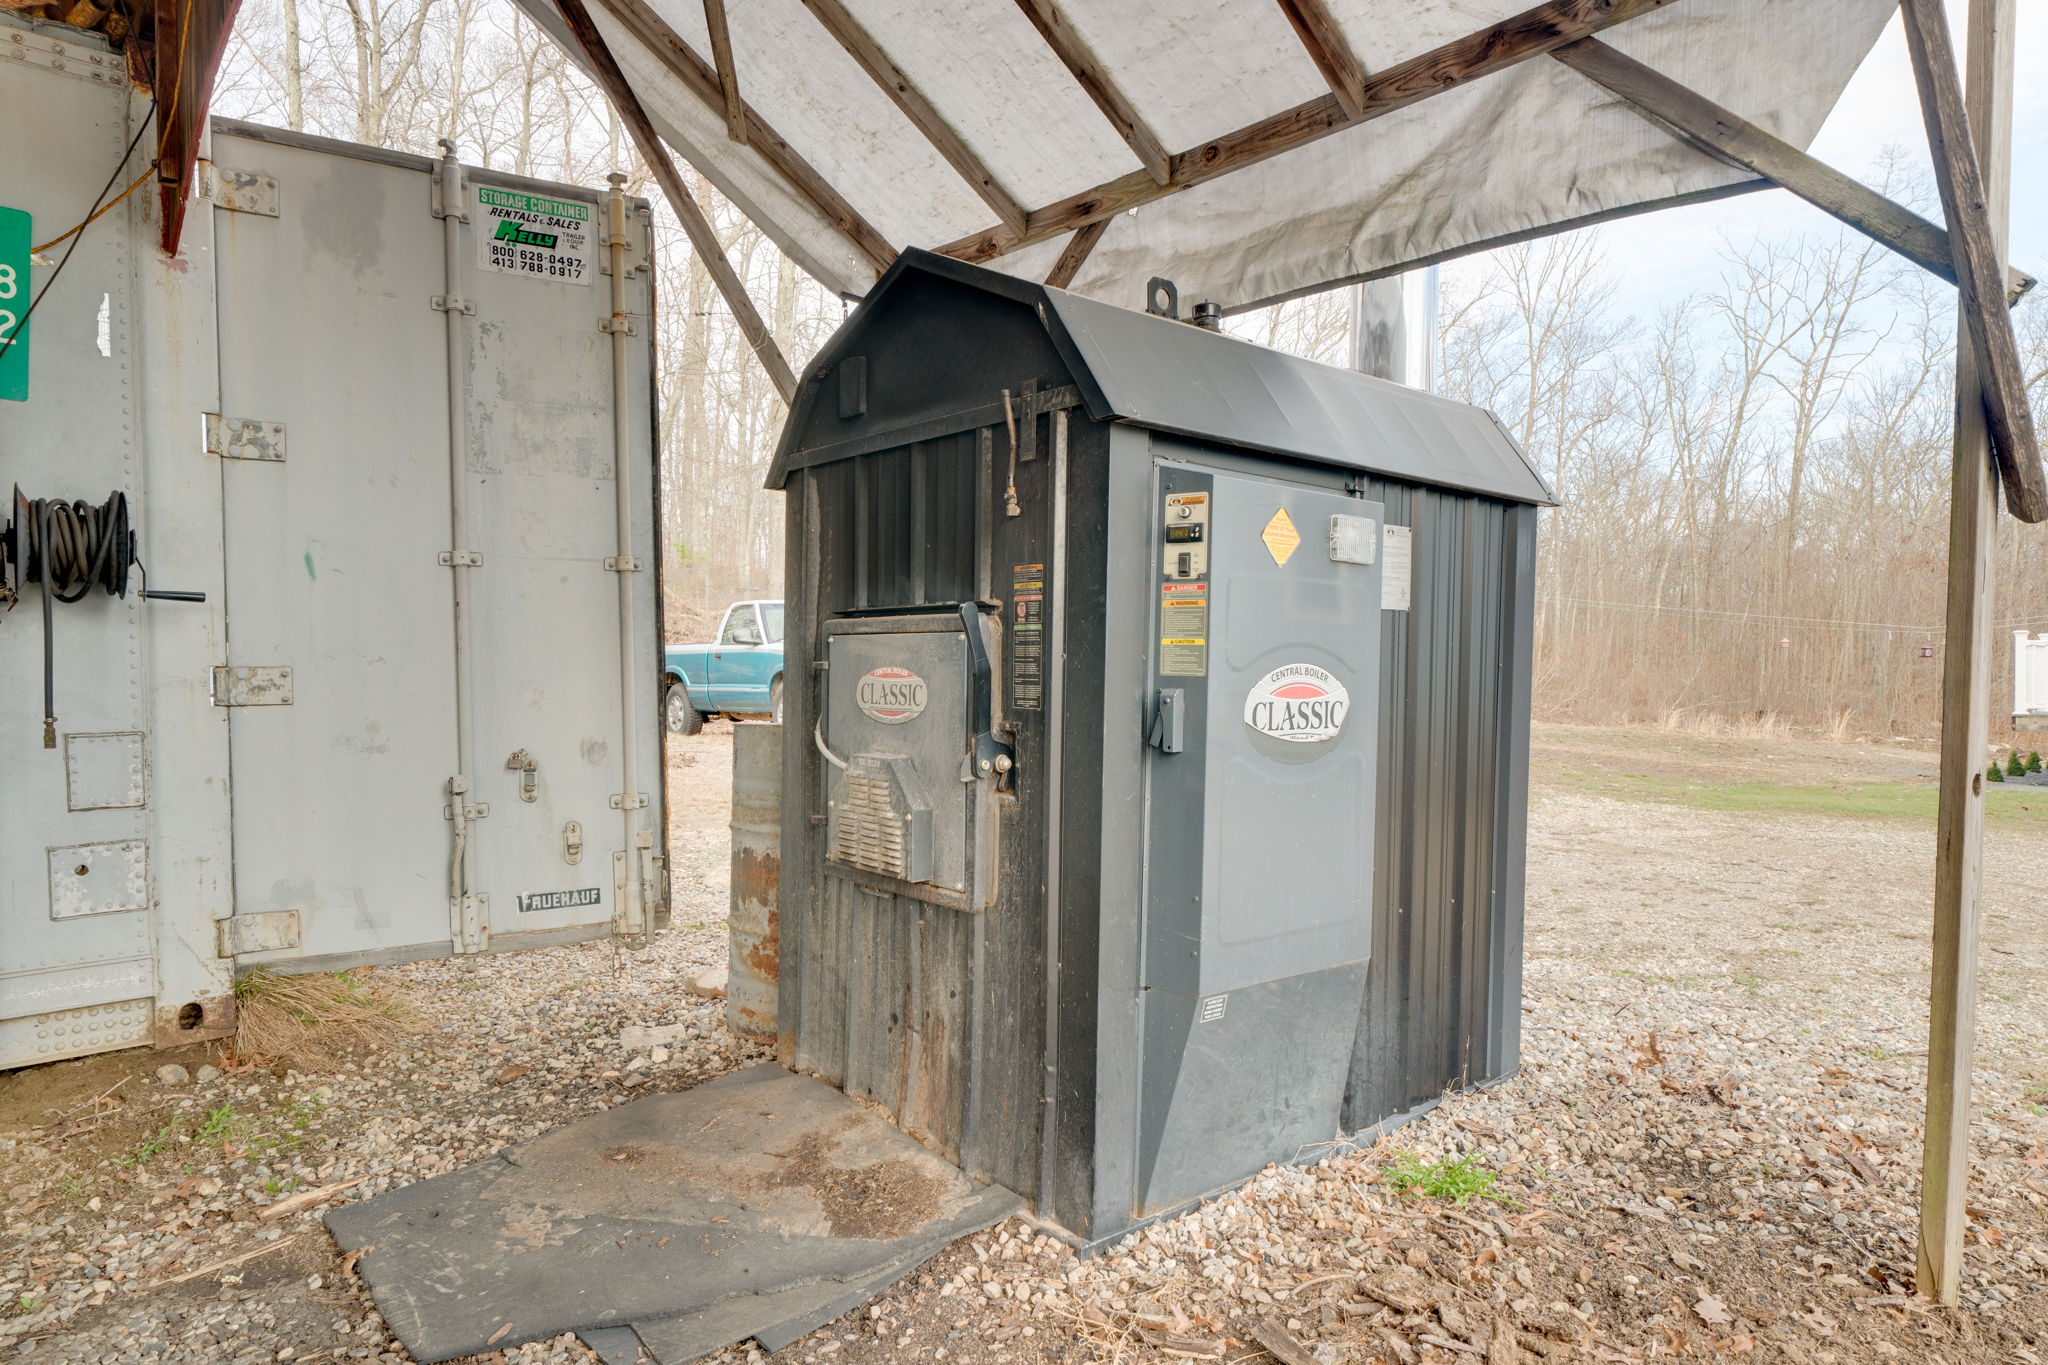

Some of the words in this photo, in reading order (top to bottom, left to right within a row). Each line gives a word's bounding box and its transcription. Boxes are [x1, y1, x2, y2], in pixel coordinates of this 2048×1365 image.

[481, 189, 528, 209] STORAGE
[530, 198, 588, 220] CONTAINER
[490, 207, 539, 223] RENTALS
[546, 217, 581, 231] SALES
[494, 219, 556, 248] KELLY
[562, 231, 586, 241] TRAILER
[520, 250, 582, 268] 628-0497
[520, 261, 581, 279] 788-0917
[1270, 666, 1303, 683] CENTRAL
[1304, 667, 1329, 683] BOILER
[860, 682, 923, 707] CLASSIC
[1251, 700, 1344, 731] CLASSIC
[520, 889, 598, 912] FRUEHAUF
